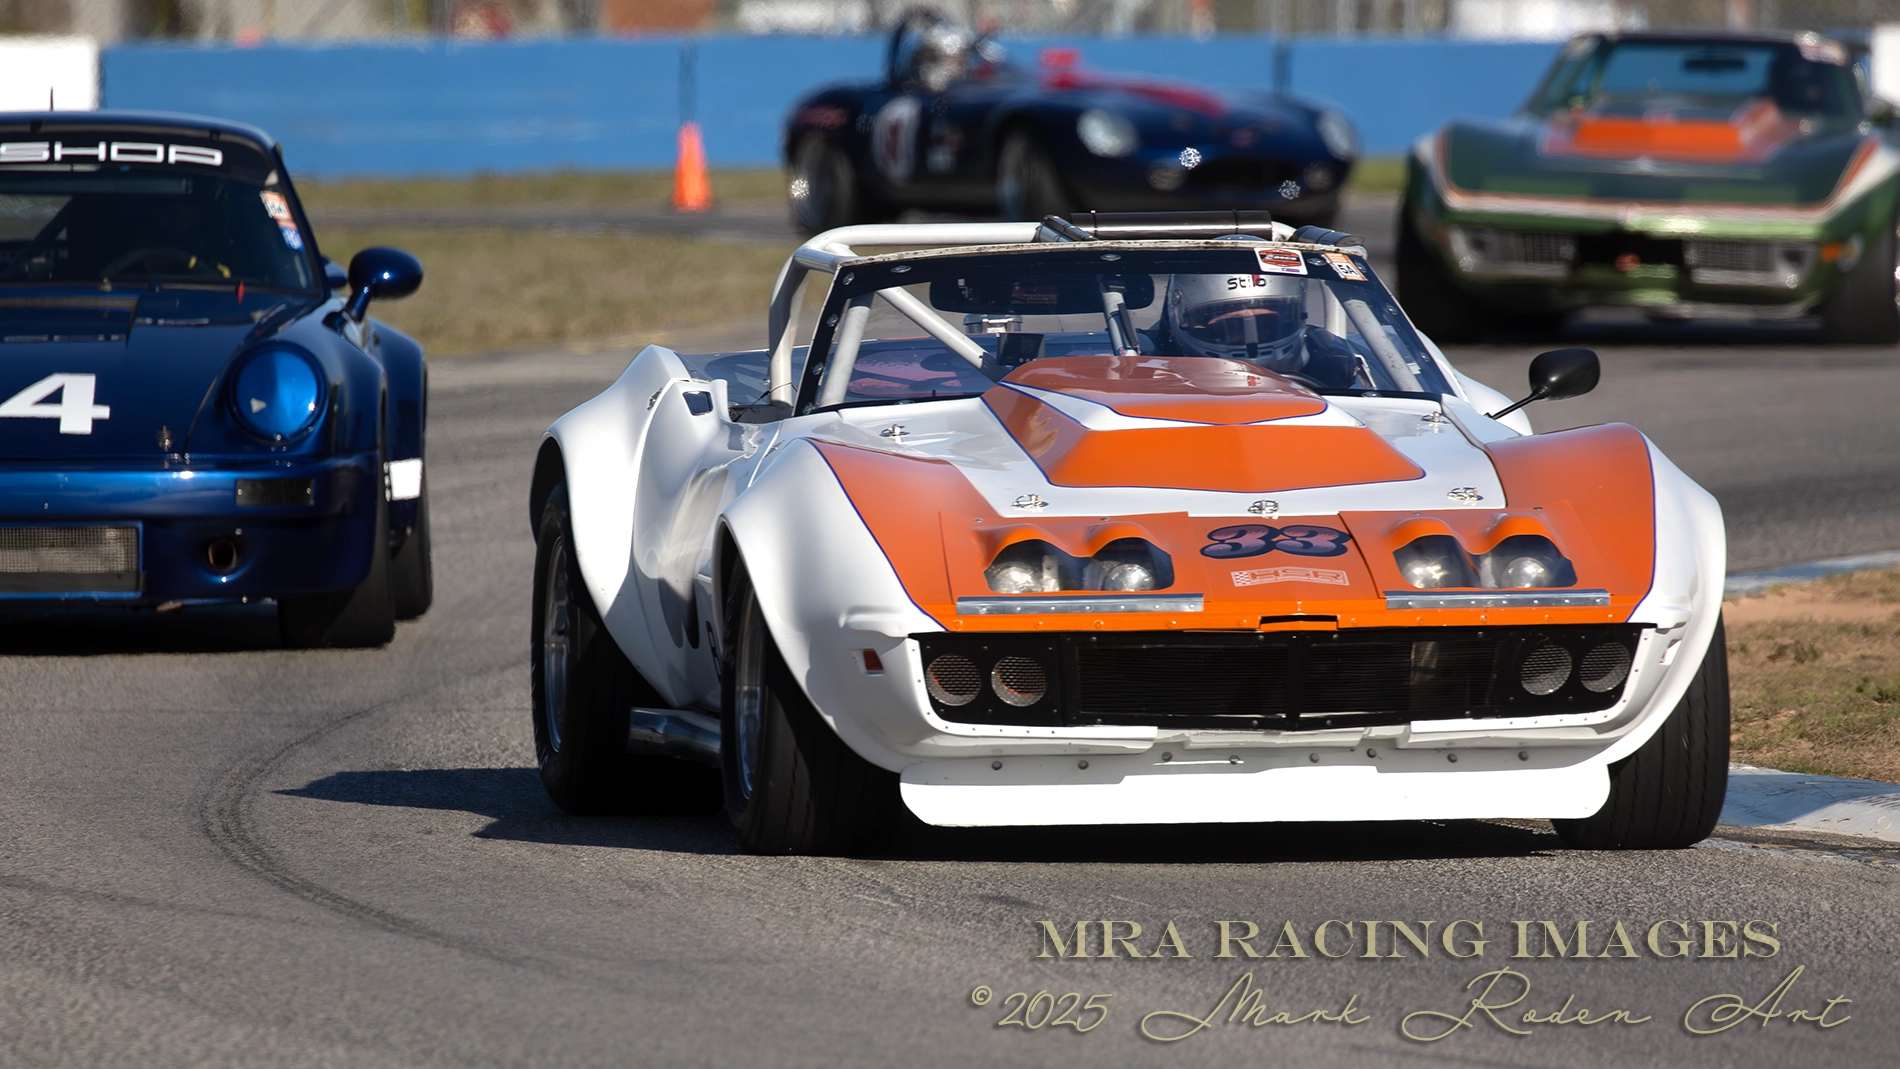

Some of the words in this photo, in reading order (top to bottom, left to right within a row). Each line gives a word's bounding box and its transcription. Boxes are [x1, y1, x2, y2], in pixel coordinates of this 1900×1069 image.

[0, 141, 223, 167] SHOP
[0, 372, 110, 435] 4
[1200, 524, 1353, 559] 33
[1249, 568, 1345, 582] HSR
